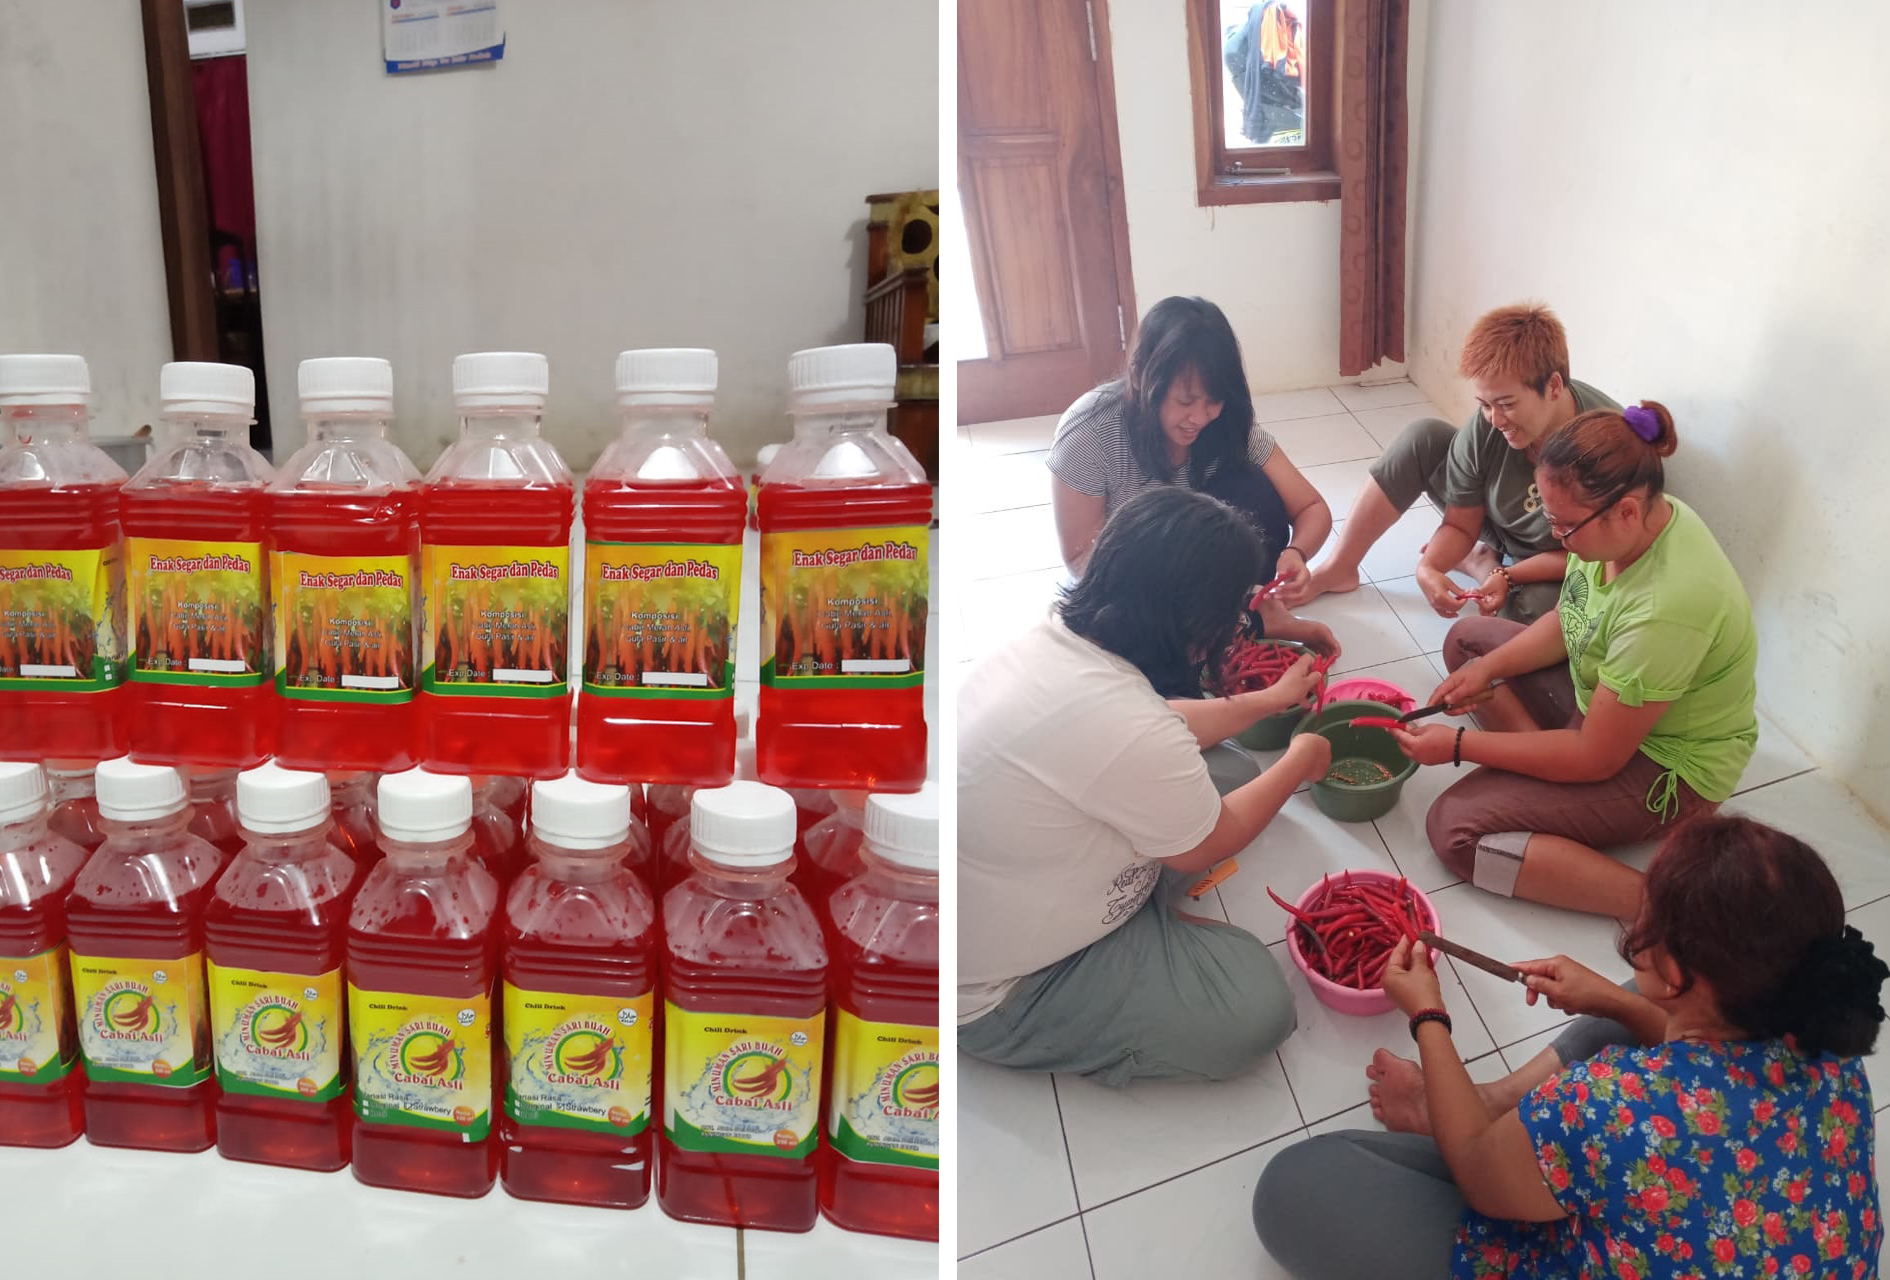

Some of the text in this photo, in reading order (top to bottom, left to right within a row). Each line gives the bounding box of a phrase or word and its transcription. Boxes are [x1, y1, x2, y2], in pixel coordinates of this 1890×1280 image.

[150, 554, 250, 574] Enak Segar dan Pedas
[792, 549, 824, 567] Enak
[825, 549, 859, 568] Segar
[860, 543, 884, 561] dan
[0, 563, 73, 583] Segar dan Pedas
[450, 561, 559, 583] Enak Segar dan Pedas
[602, 560, 719, 582] Enak Segar dan Pedas
[300, 570, 403, 591] Enak Segar dan Pedas
[827, 598, 878, 608] Komposisi
[480, 609, 525, 619] Komposisi
[631, 611, 679, 620] Komposisi
[812, 661, 834, 670] Date
[614, 672, 635, 681] Date
[254, 995, 272, 1008] SARI
[275, 995, 299, 1009] BUAH
[100, 1029, 164, 1043] Cabai Asli
[406, 1021, 424, 1035] SARI
[426, 1021, 452, 1037] BUAH
[561, 1021, 582, 1035] SARI
[584, 1021, 611, 1037] BUAH
[246, 1044, 310, 1061] Cabai Asli
[711, 1041, 783, 1093] MINUMAN SARI BUAH
[394, 1073, 463, 1091] Cabai Asli
[548, 1073, 620, 1091] Cabai Asli
[880, 1061, 903, 1103] MINUMAN
[902, 1052, 925, 1066] SARI
[715, 1095, 793, 1112] Cabai Asli
[883, 1105, 930, 1119] Cabai
